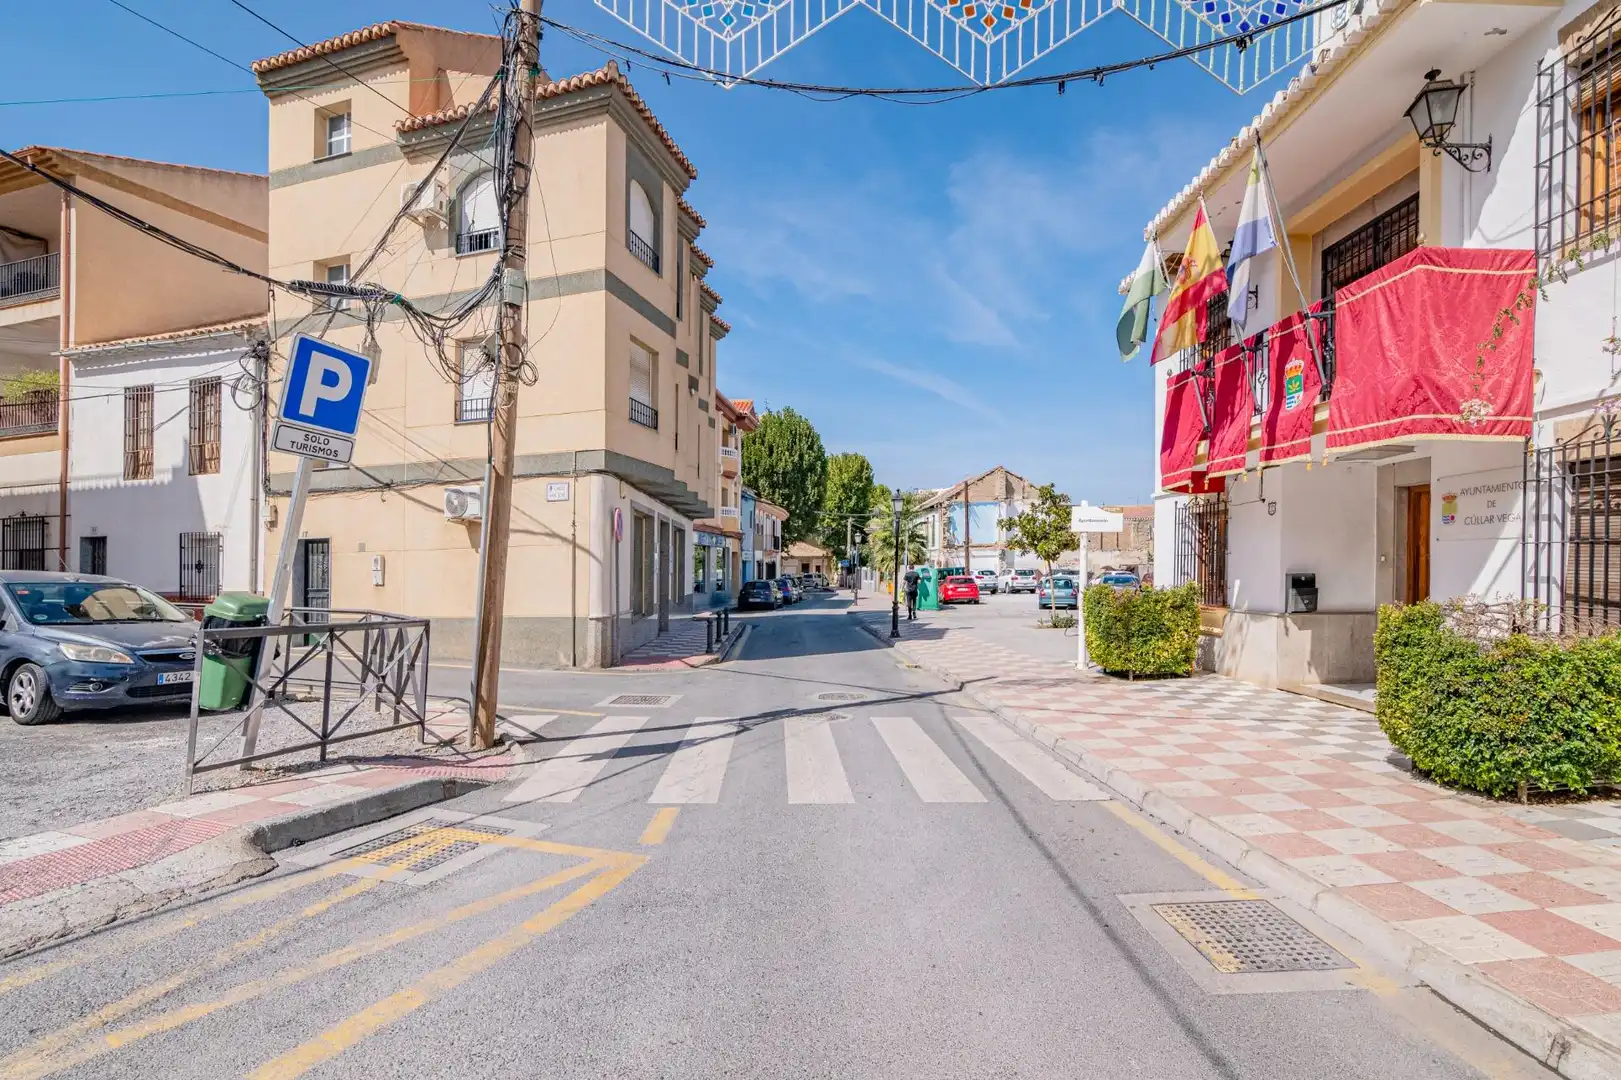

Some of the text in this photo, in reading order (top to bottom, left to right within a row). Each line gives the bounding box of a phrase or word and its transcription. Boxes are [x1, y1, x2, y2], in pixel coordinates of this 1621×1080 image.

[299, 351, 353, 417] P
[304, 433, 330, 446] SOLO
[290, 440, 339, 457] TURISMOS
[1460, 481, 1525, 496] AYUNTAMIENTO
[1487, 500, 1496, 508] DE
[1464, 512, 1521, 526] CÚLLAR VEGA
[165, 672, 191, 682] 4342
